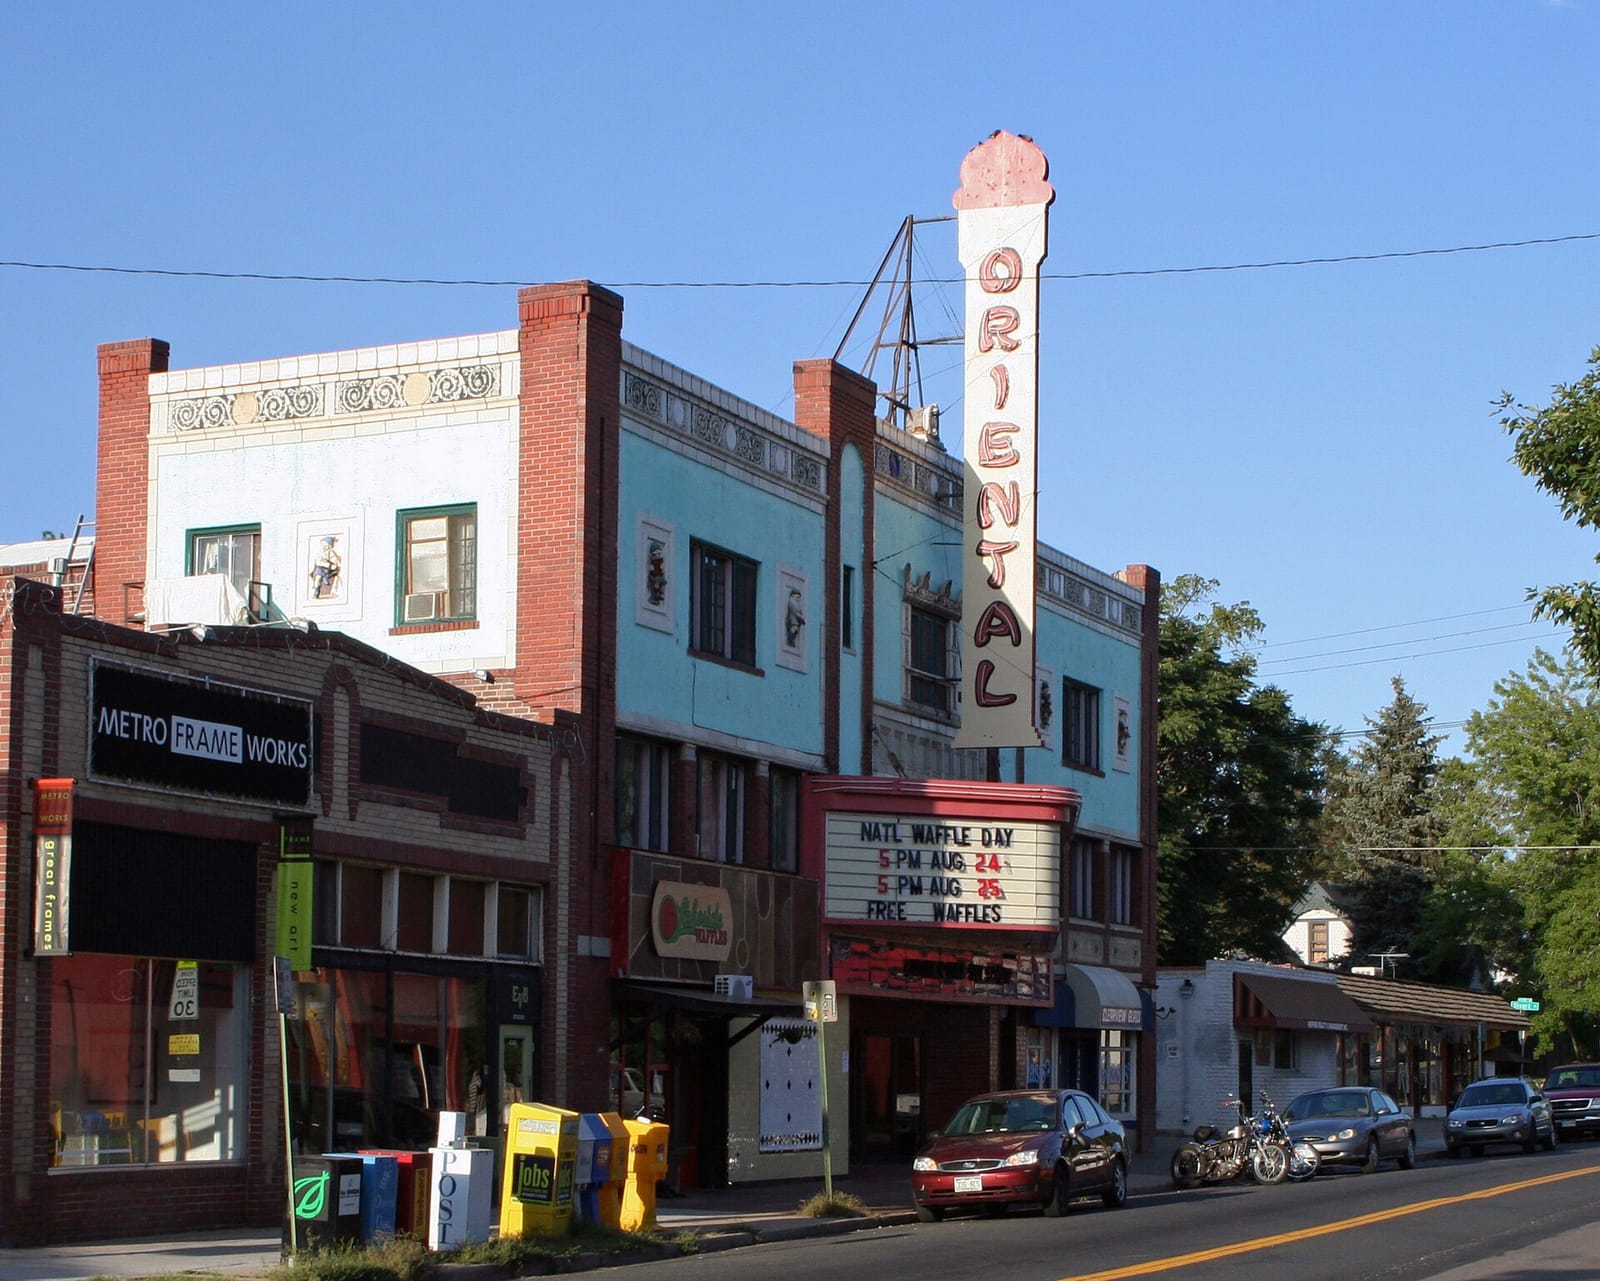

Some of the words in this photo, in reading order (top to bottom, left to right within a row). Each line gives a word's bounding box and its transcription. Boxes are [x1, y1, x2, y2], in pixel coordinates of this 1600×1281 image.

[975, 247, 1022, 707] ORIENTAL
[98, 706, 168, 745] METRO
[175, 722, 238, 757] FRAME
[246, 734, 307, 768] WORKS
[40, 791, 70, 800] METRO
[860, 822, 902, 843] NATL
[911, 823, 972, 846] WAFFLE
[981, 827, 1014, 848] DAY
[44, 840, 55, 886] great
[879, 849, 890, 869] 5
[897, 850, 922, 869] PM
[930, 851, 964, 871] AUG
[290, 881, 298, 914] new
[878, 874, 889, 894] 5
[898, 875, 923, 895] PM
[929, 876, 962, 896] AUG
[977, 878, 1001, 898] 25
[44, 894, 56, 950] frames
[867, 901, 907, 921] FREE
[932, 903, 1002, 923] WAFFLES
[289, 926, 298, 951] art
[515, 1155, 550, 1200] jobs
[438, 1151, 457, 1244] POST
